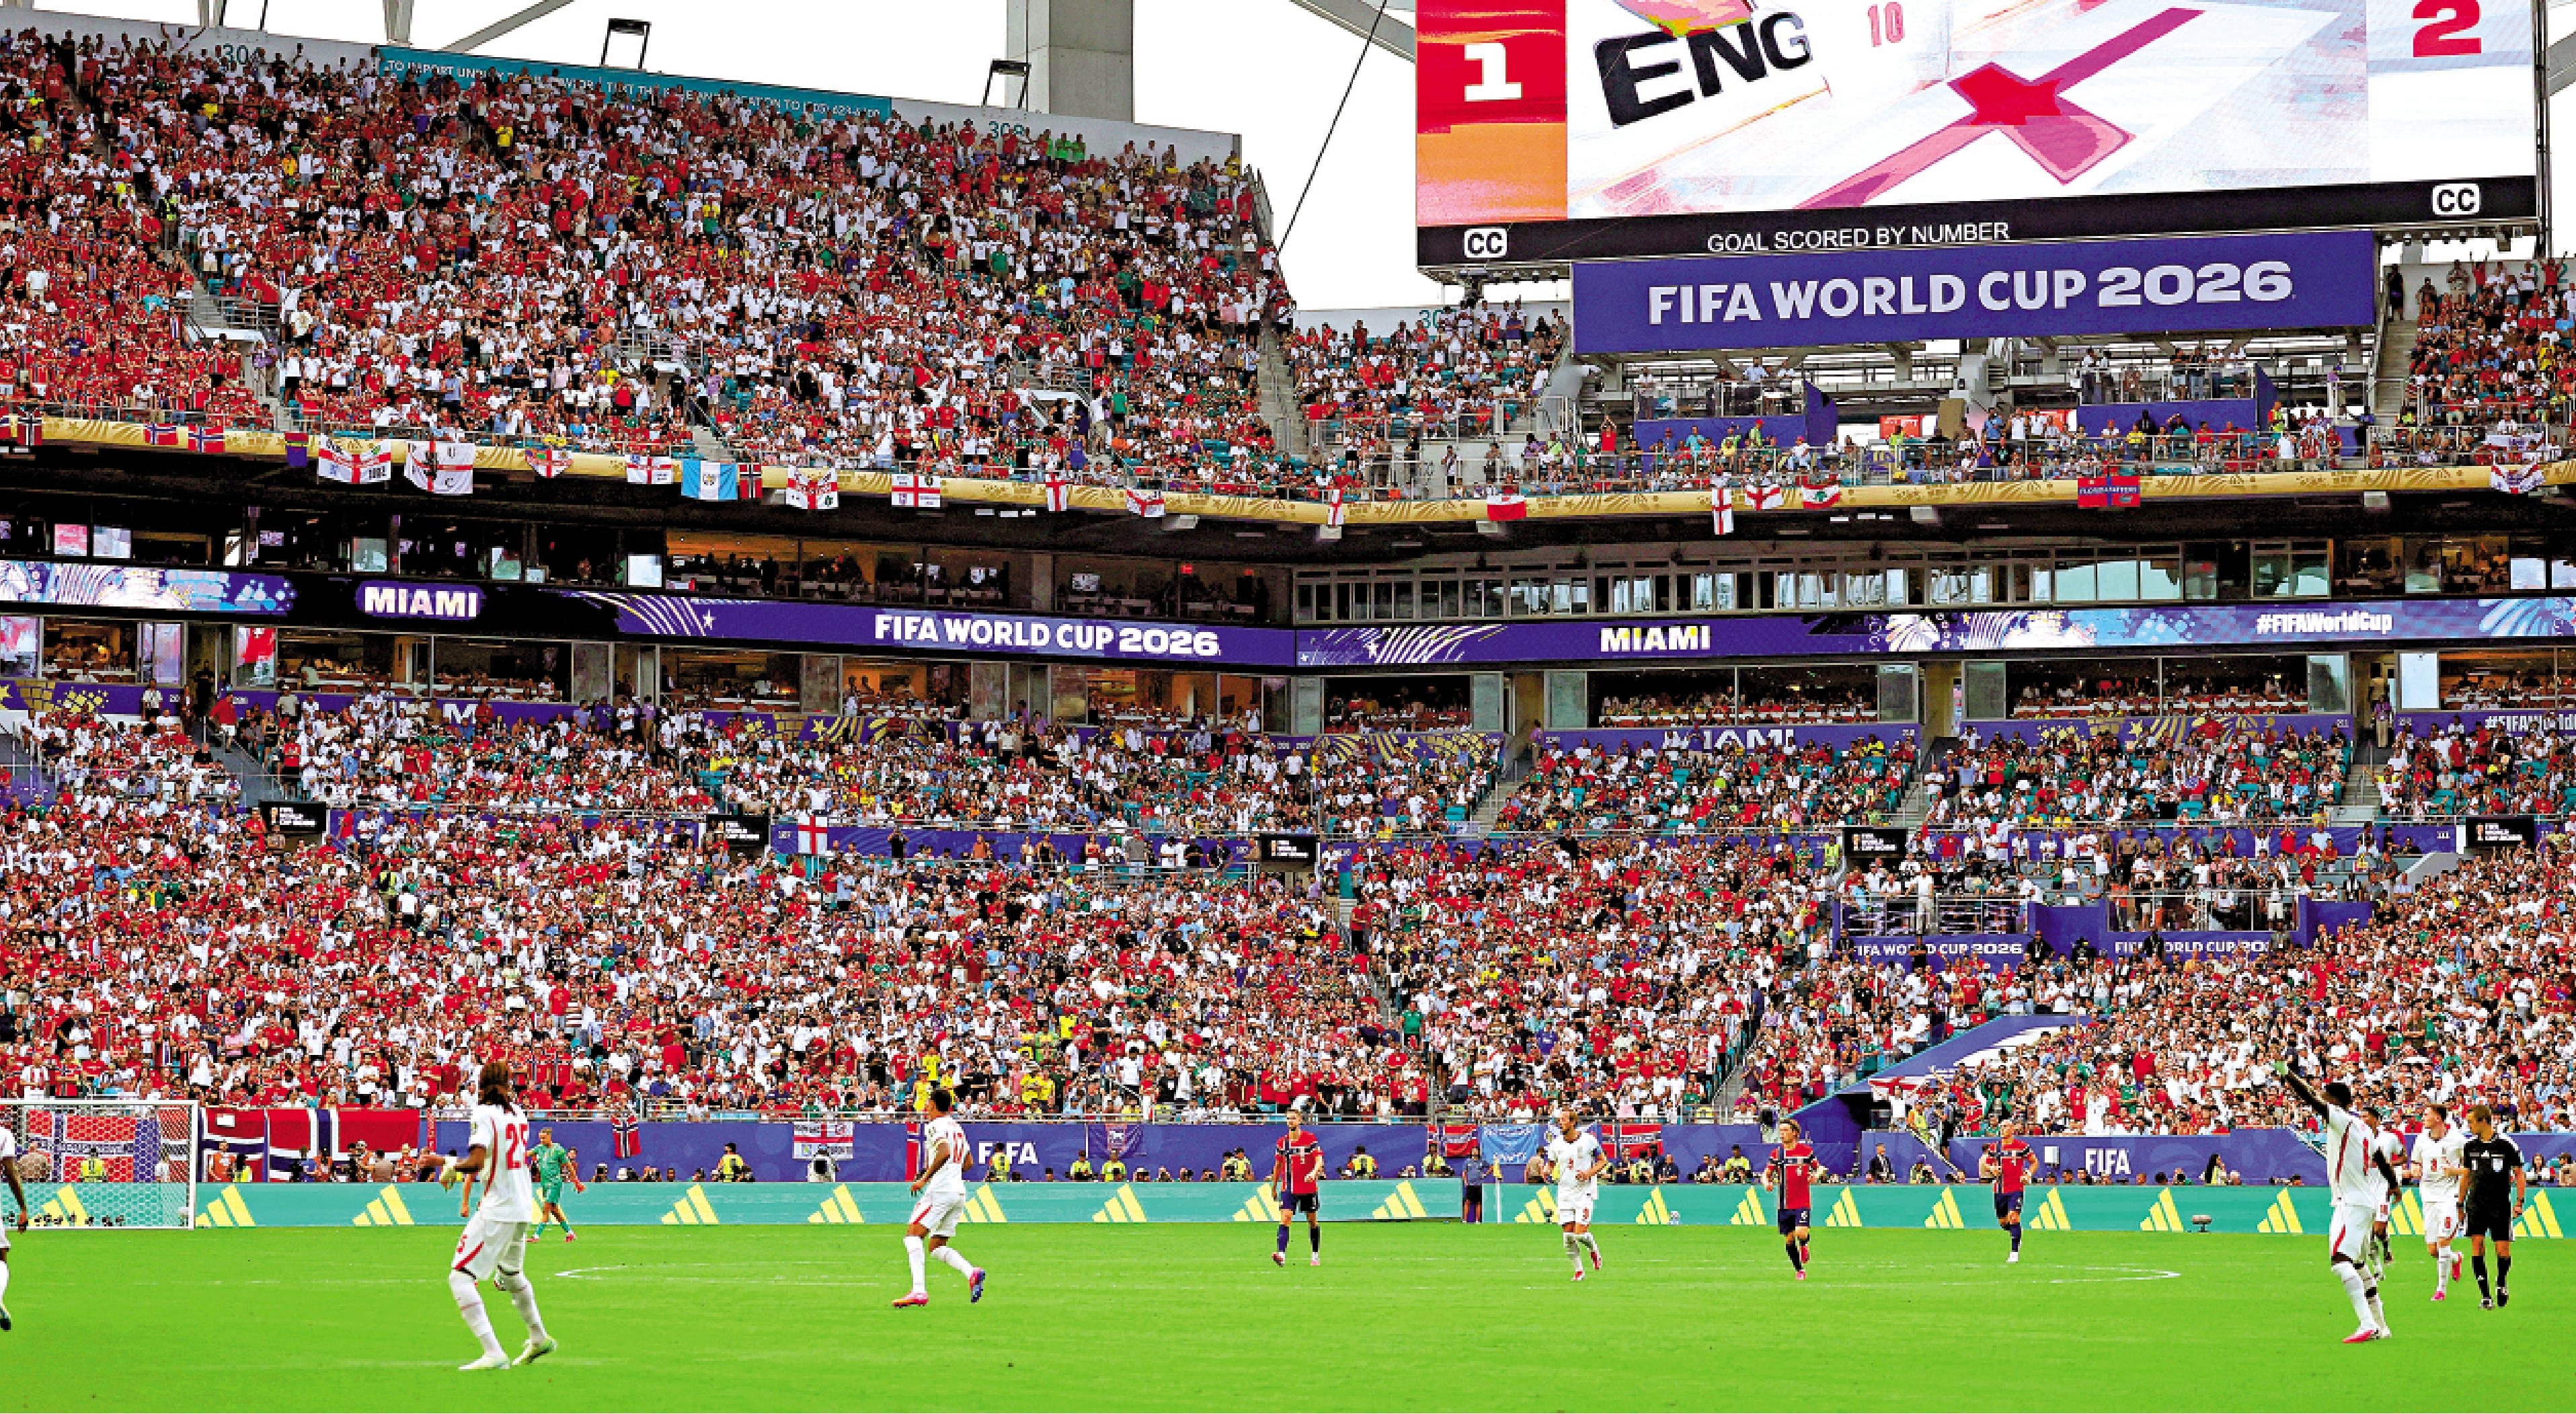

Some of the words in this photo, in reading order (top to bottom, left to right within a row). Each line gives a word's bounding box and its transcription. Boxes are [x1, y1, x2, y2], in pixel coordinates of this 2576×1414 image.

[2413, 0, 2480, 57] 2
[223, 43, 264, 65] 30
[1464, 43, 1522, 102] 1
[1594, 12, 1813, 129] ENG
[2437, 189, 2476, 212] CC
[1467, 233, 1504, 254] CC
[1709, 233, 1769, 251] GOAL
[1774, 229, 1868, 249] SCORED
[1876, 228, 1906, 245] BY
[1912, 223, 2008, 243] NUMBER
[1649, 284, 1762, 324] FIFA
[1770, 276, 1966, 319] WORLD
[1978, 270, 2086, 311] CUP
[2097, 261, 2293, 307] 2026
[364, 586, 477, 617] MIAMI
[875, 614, 939, 643] FIFA
[943, 619, 1048, 647] WORLD
[1056, 623, 1114, 650] CUP
[1119, 629, 1219, 656] 2026
[2257, 613, 2393, 634] #FIFAWorldCup
[1601, 627, 1710, 650] MIAMI
[1972, 943, 2023, 954] 2026
[2206, 941, 2234, 952] CUP
[978, 1142, 1038, 1165] FFA
[2085, 1148, 2131, 1175] FIFA
